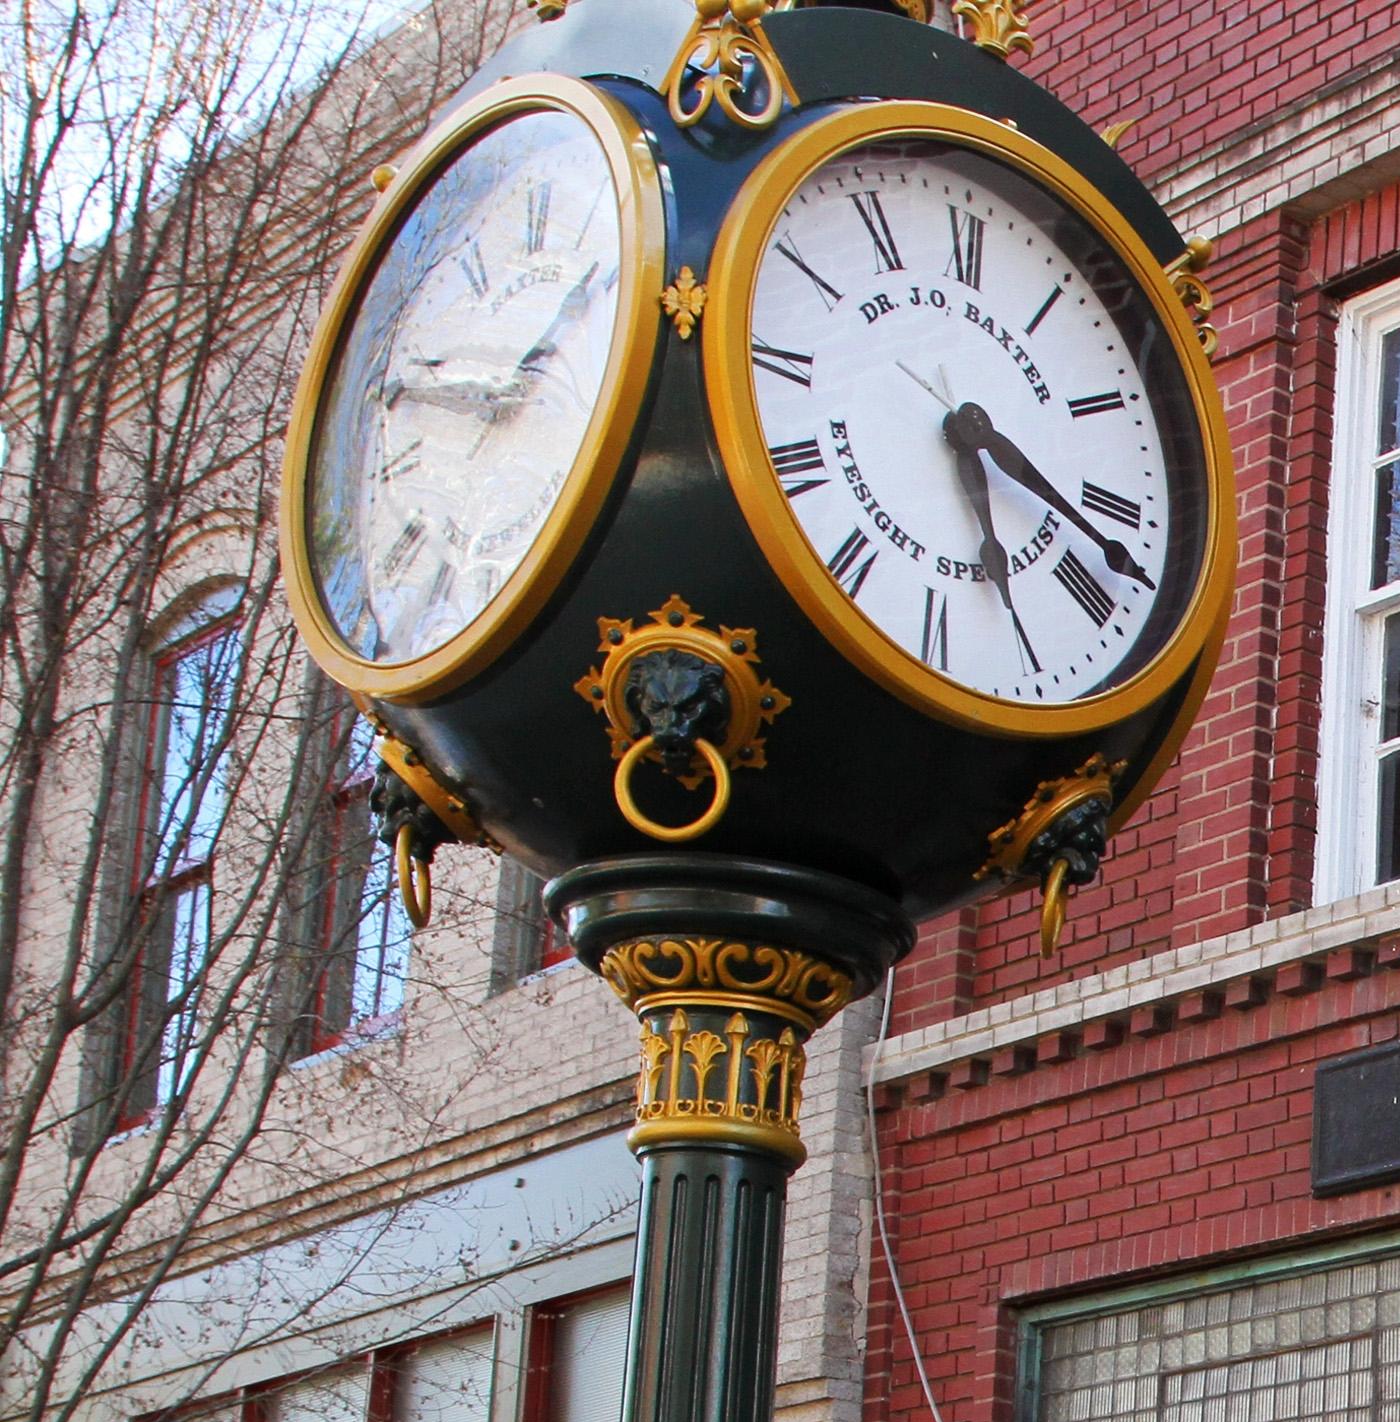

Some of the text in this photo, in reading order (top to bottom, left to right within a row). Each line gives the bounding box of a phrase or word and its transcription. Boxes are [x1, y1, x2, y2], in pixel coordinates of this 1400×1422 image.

[858, 292, 900, 325] DR.
[963, 301, 1053, 406] BAXTER
[829, 418, 1062, 584] EYESIGHT SPEALIST
